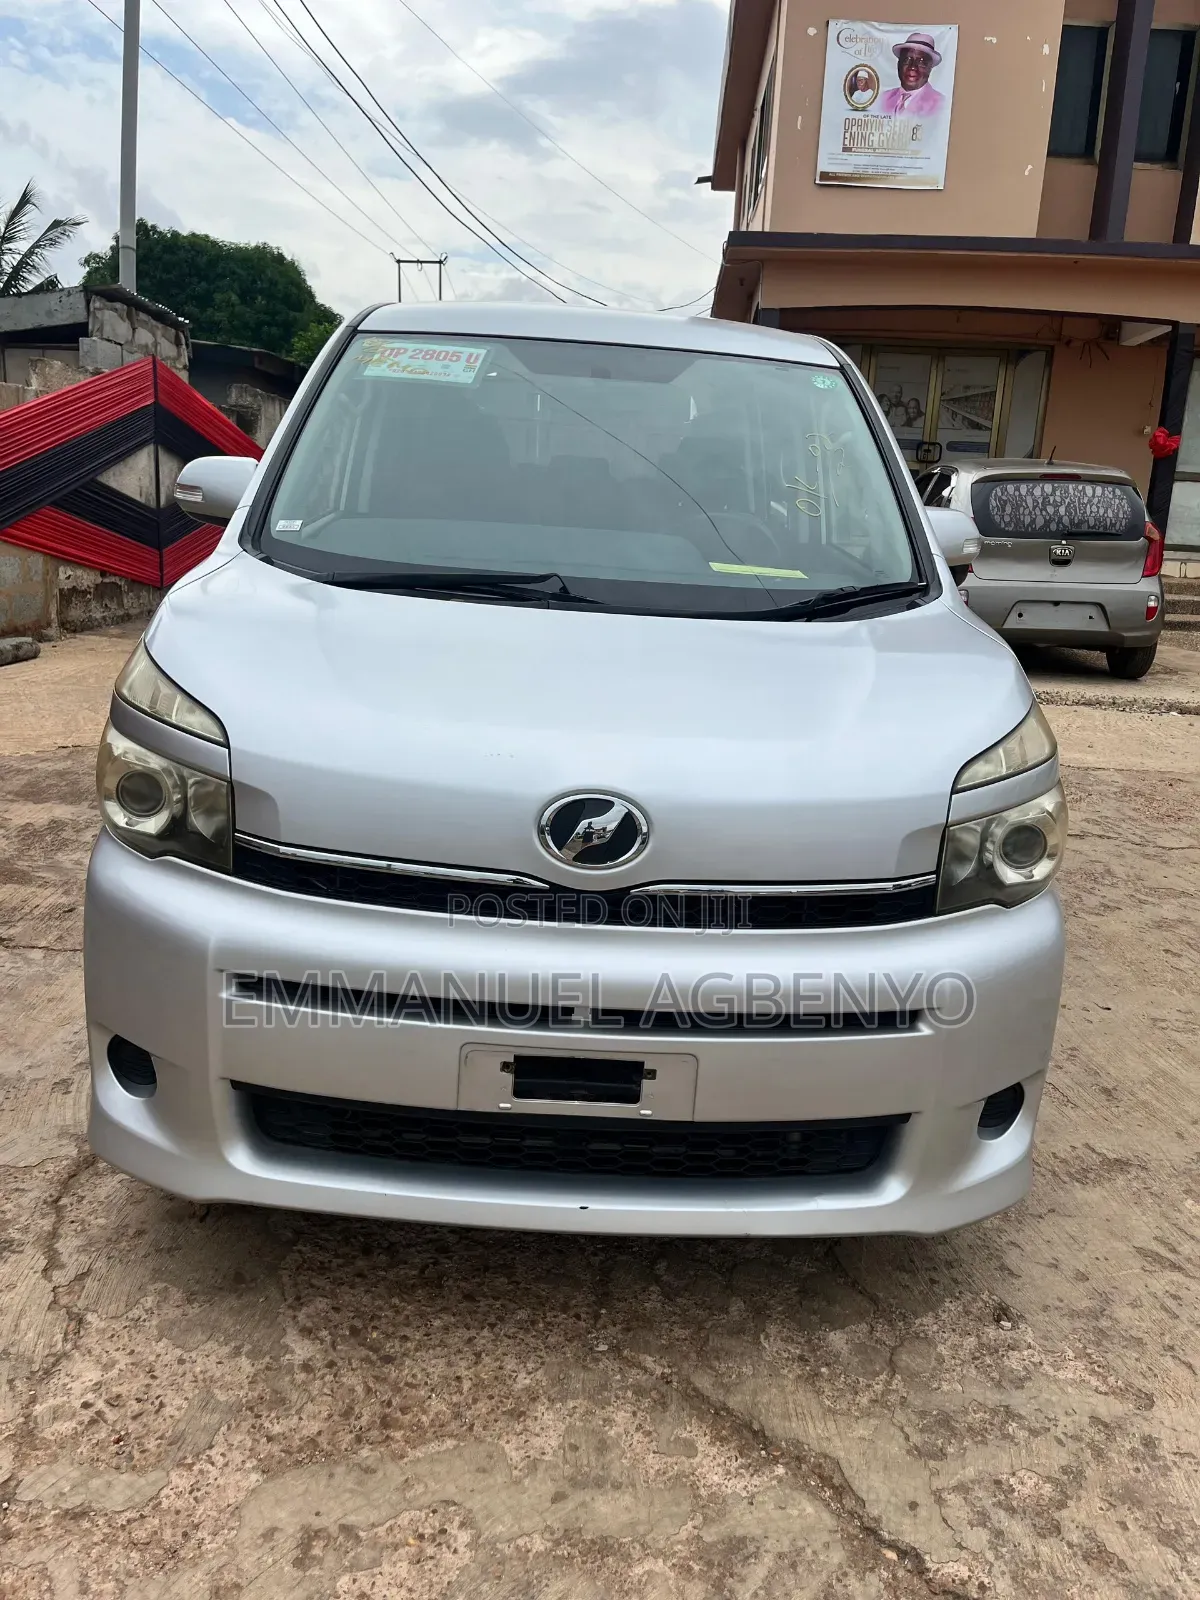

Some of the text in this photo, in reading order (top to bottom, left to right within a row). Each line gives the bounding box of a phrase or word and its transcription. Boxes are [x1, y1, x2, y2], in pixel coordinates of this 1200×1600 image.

[844, 117, 884, 132] OPANYIN
[843, 131, 875, 147] ENING
[408, 348, 463, 362] 2805
[466, 352, 481, 364] U
